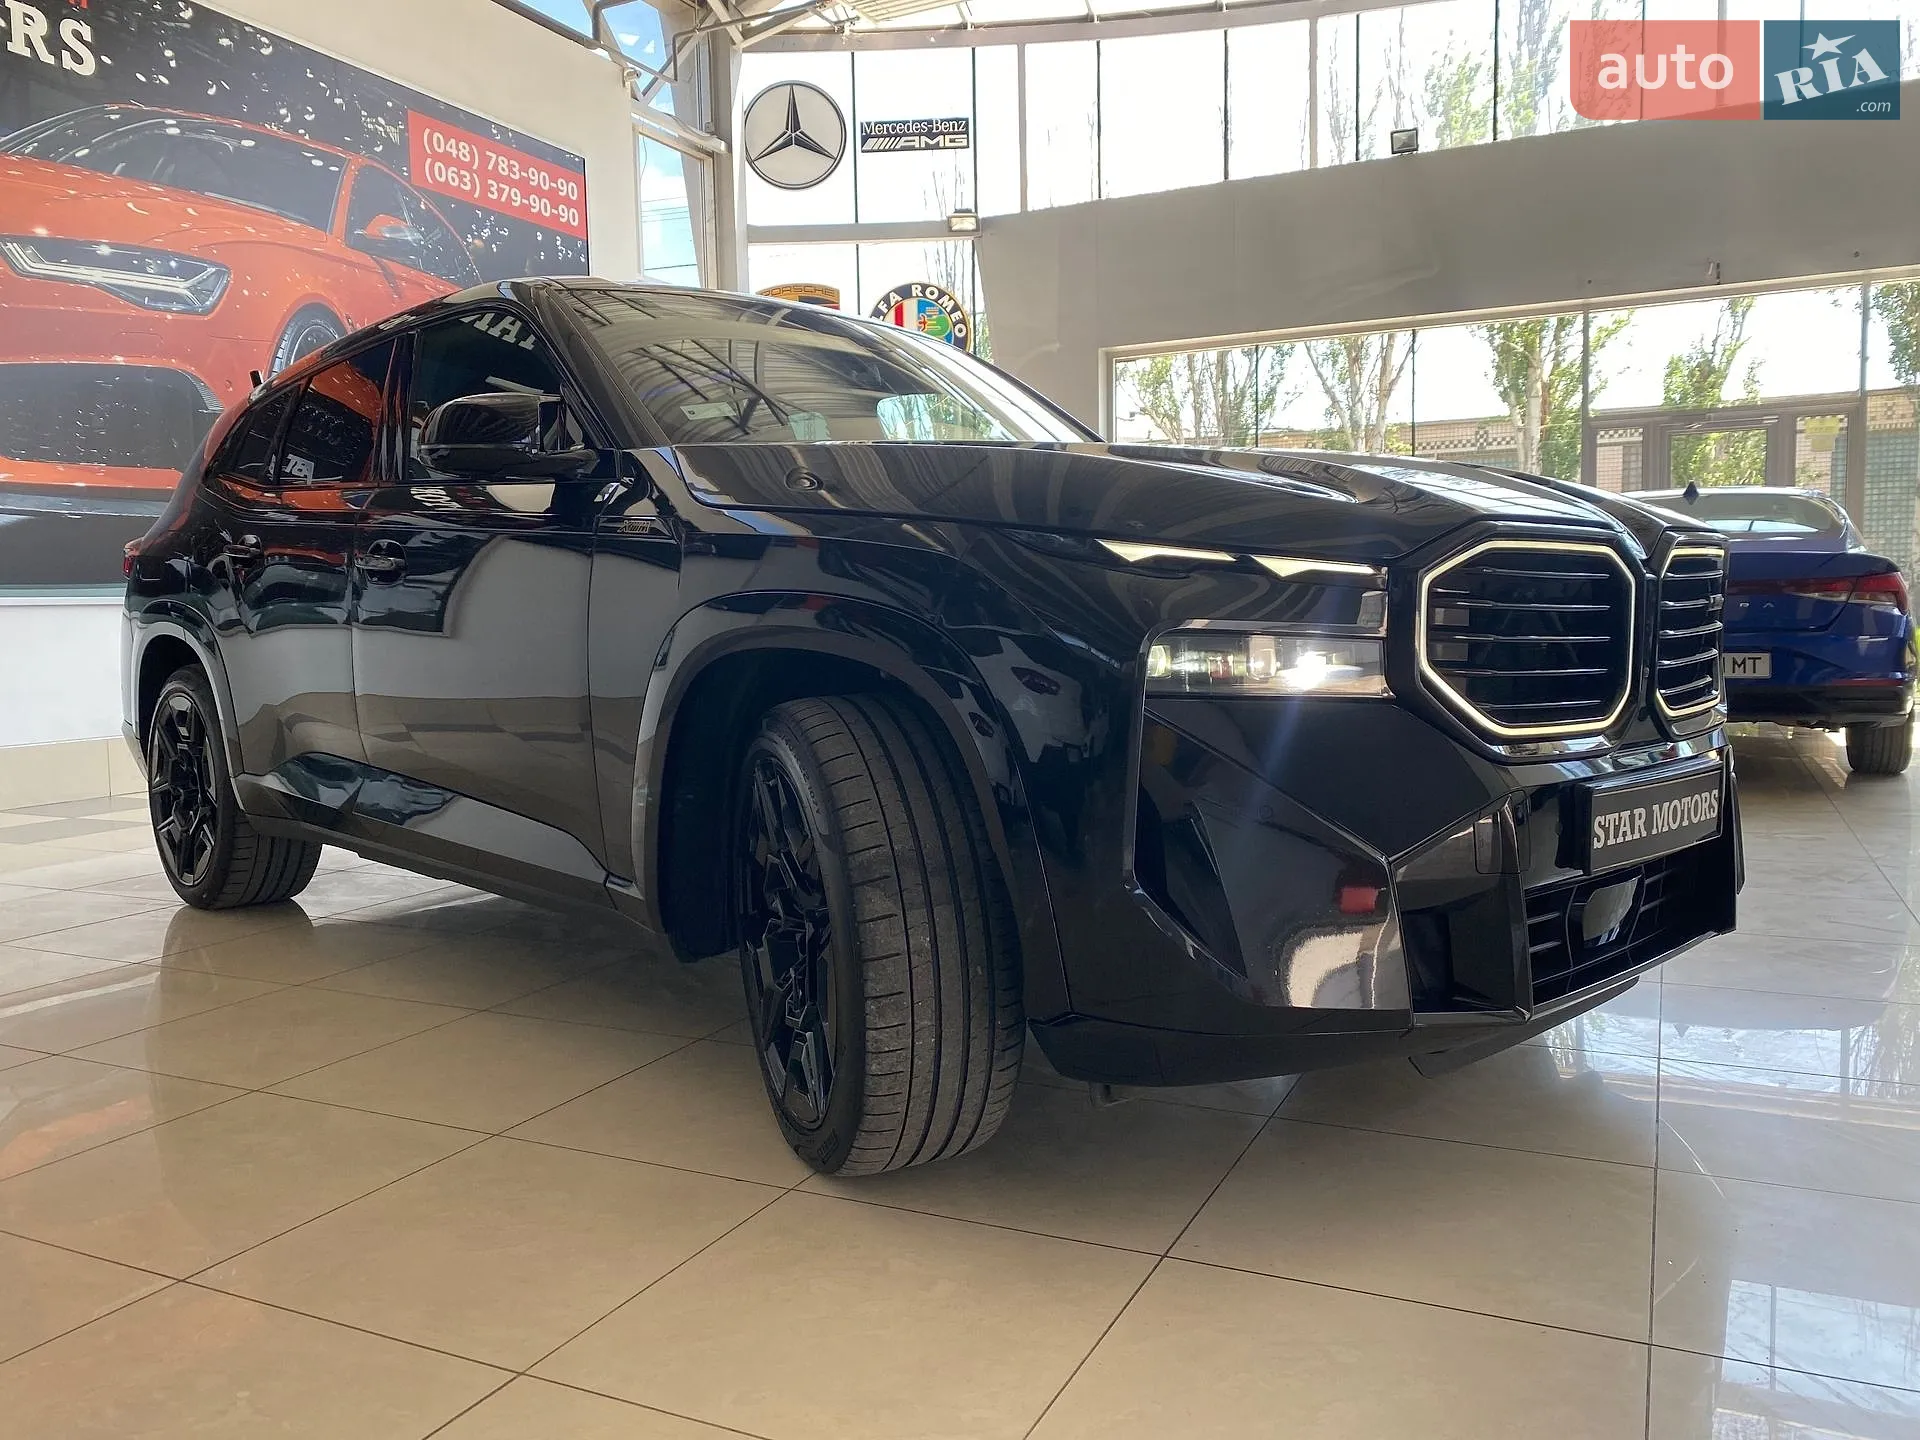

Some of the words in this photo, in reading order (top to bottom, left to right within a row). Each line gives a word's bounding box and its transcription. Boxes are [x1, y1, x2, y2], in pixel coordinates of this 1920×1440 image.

[861, 119, 967, 135] Mercedes-Benz
[423, 127, 479, 169] (048)
[486, 151, 579, 201] 783-90-90
[424, 157, 481, 198] (063)
[487, 178, 579, 227] 379-90-90
[911, 284, 967, 338] ROMEO
[1732, 656, 1762, 674] MT
[1593, 807, 1647, 849] STAR
[1651, 789, 1719, 835] MOTORS
